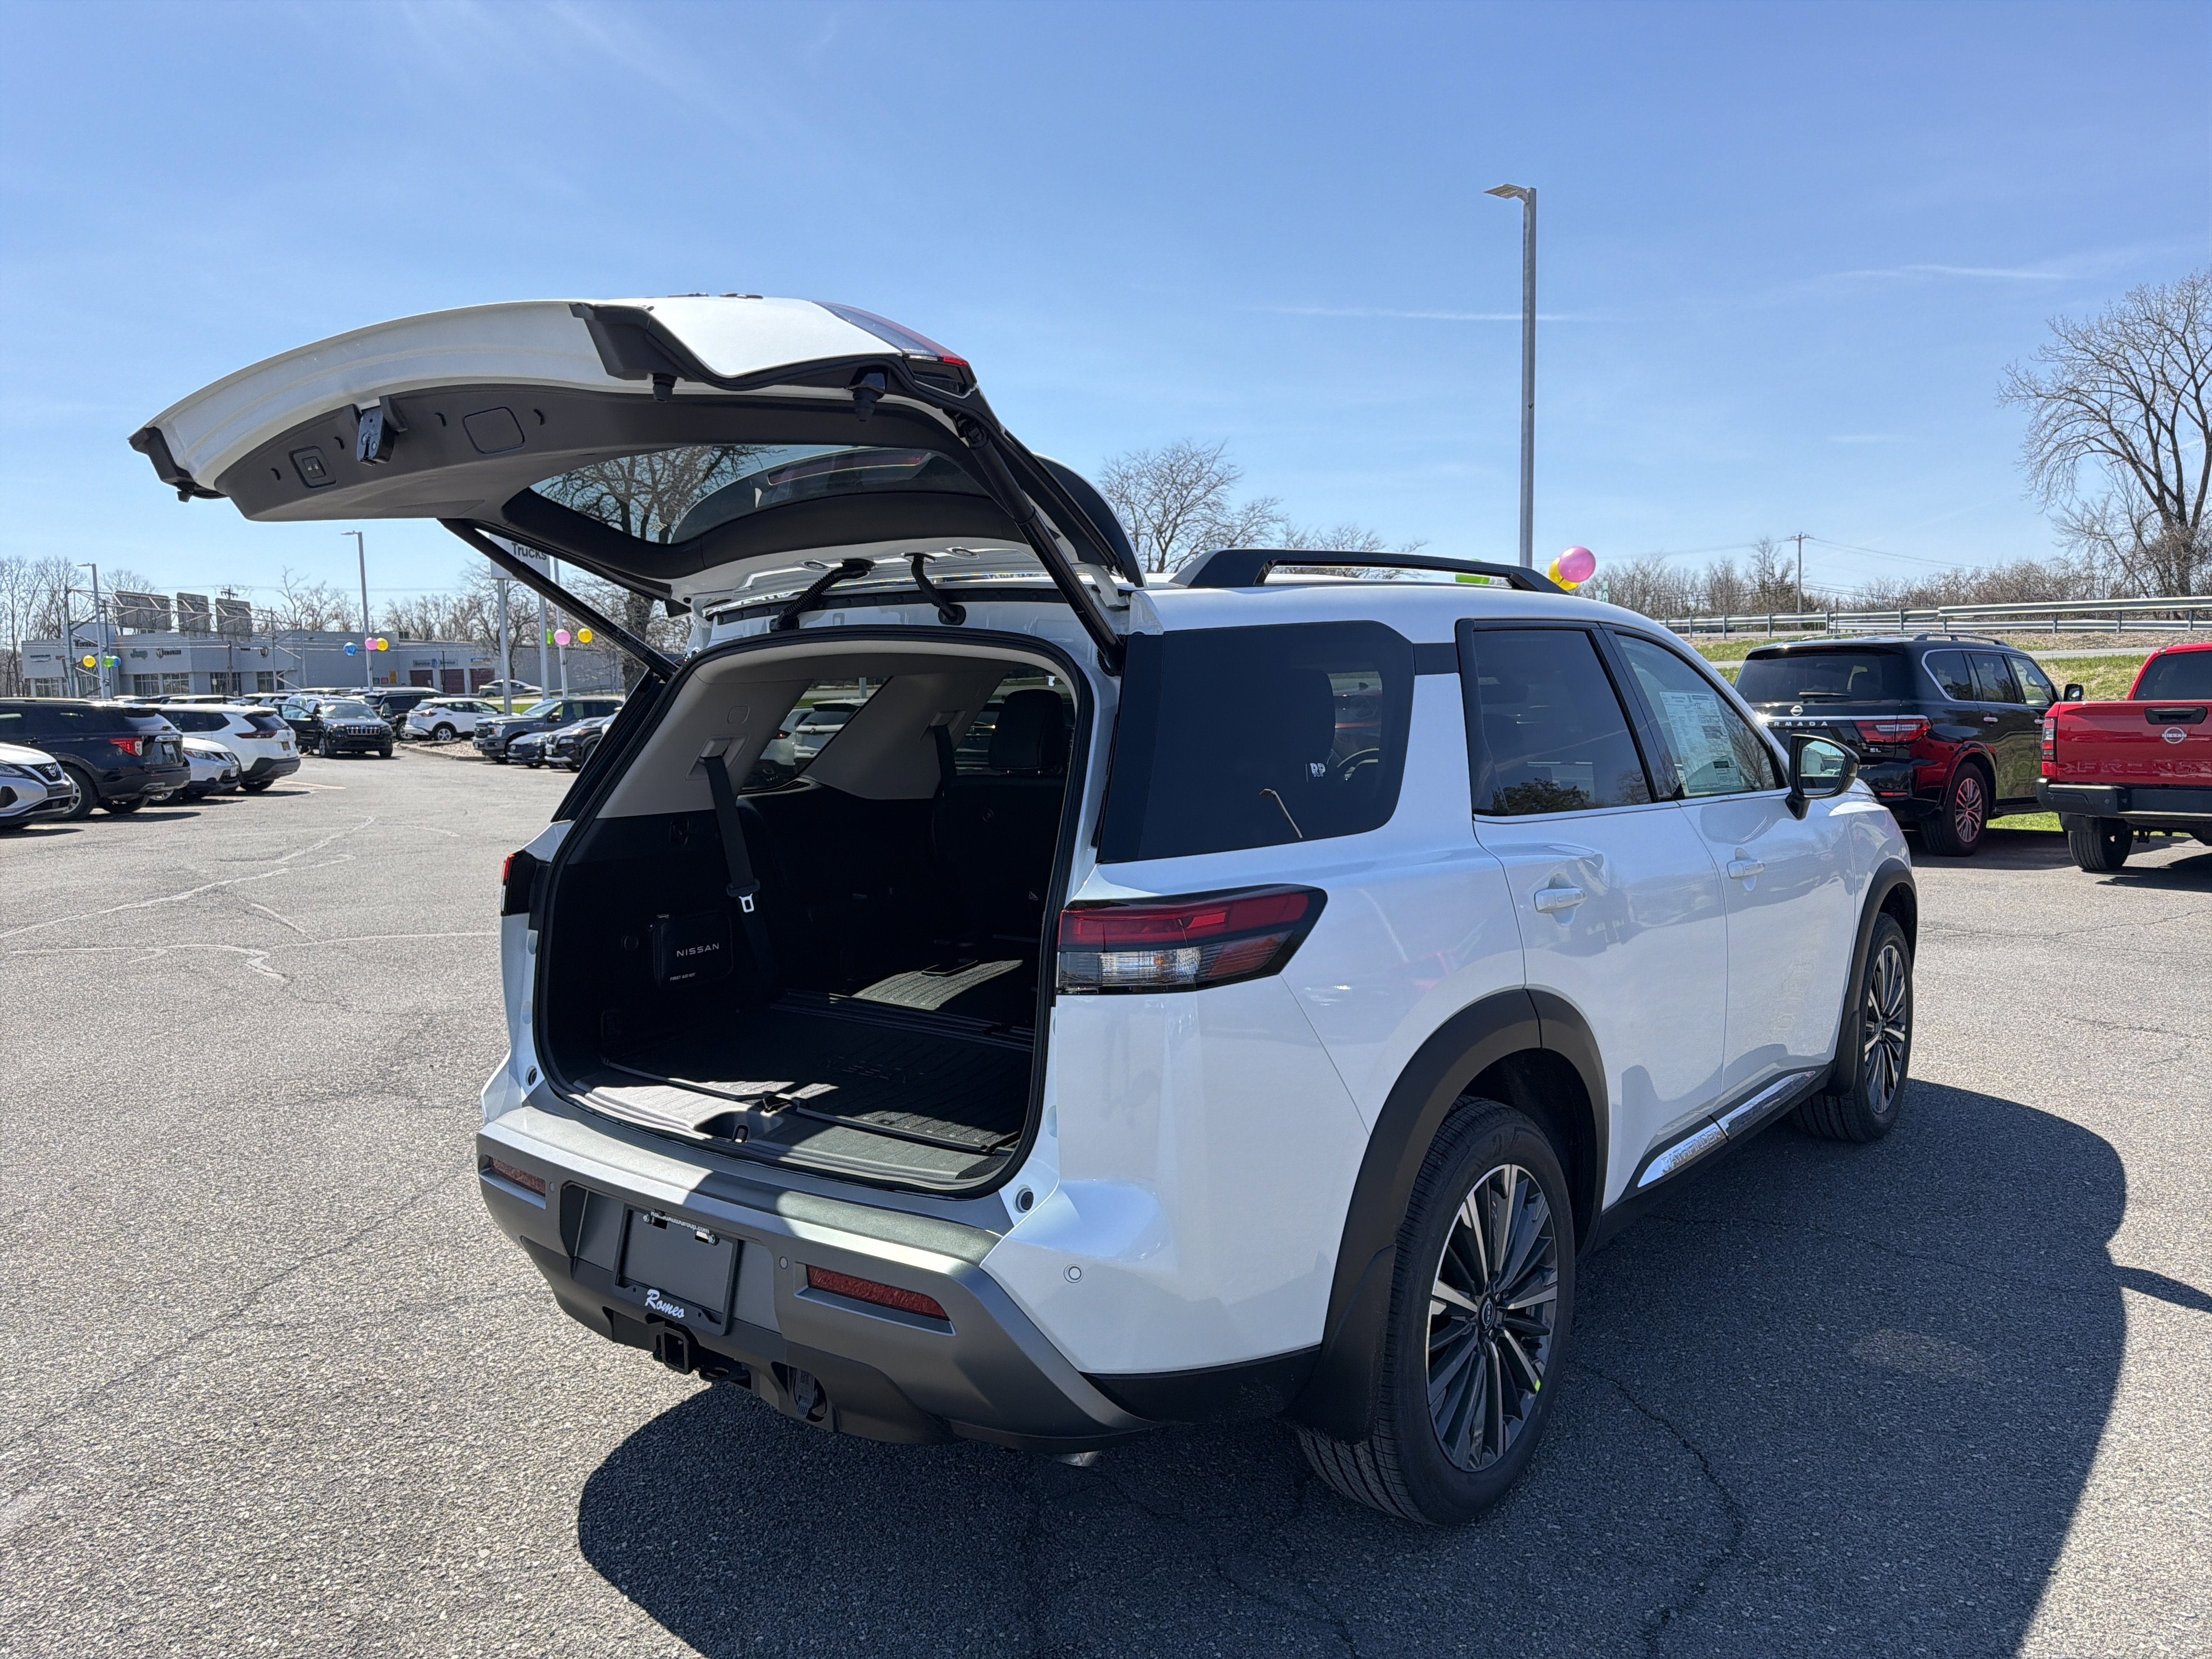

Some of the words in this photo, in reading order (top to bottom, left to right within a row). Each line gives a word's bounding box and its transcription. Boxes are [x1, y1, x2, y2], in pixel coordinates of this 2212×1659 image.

[511, 542, 547, 560] Trucks
[676, 943, 719, 957] NISSAN
[1661, 1127, 1721, 1169] PATHFINDER
[645, 1289, 685, 1319] Romeo
